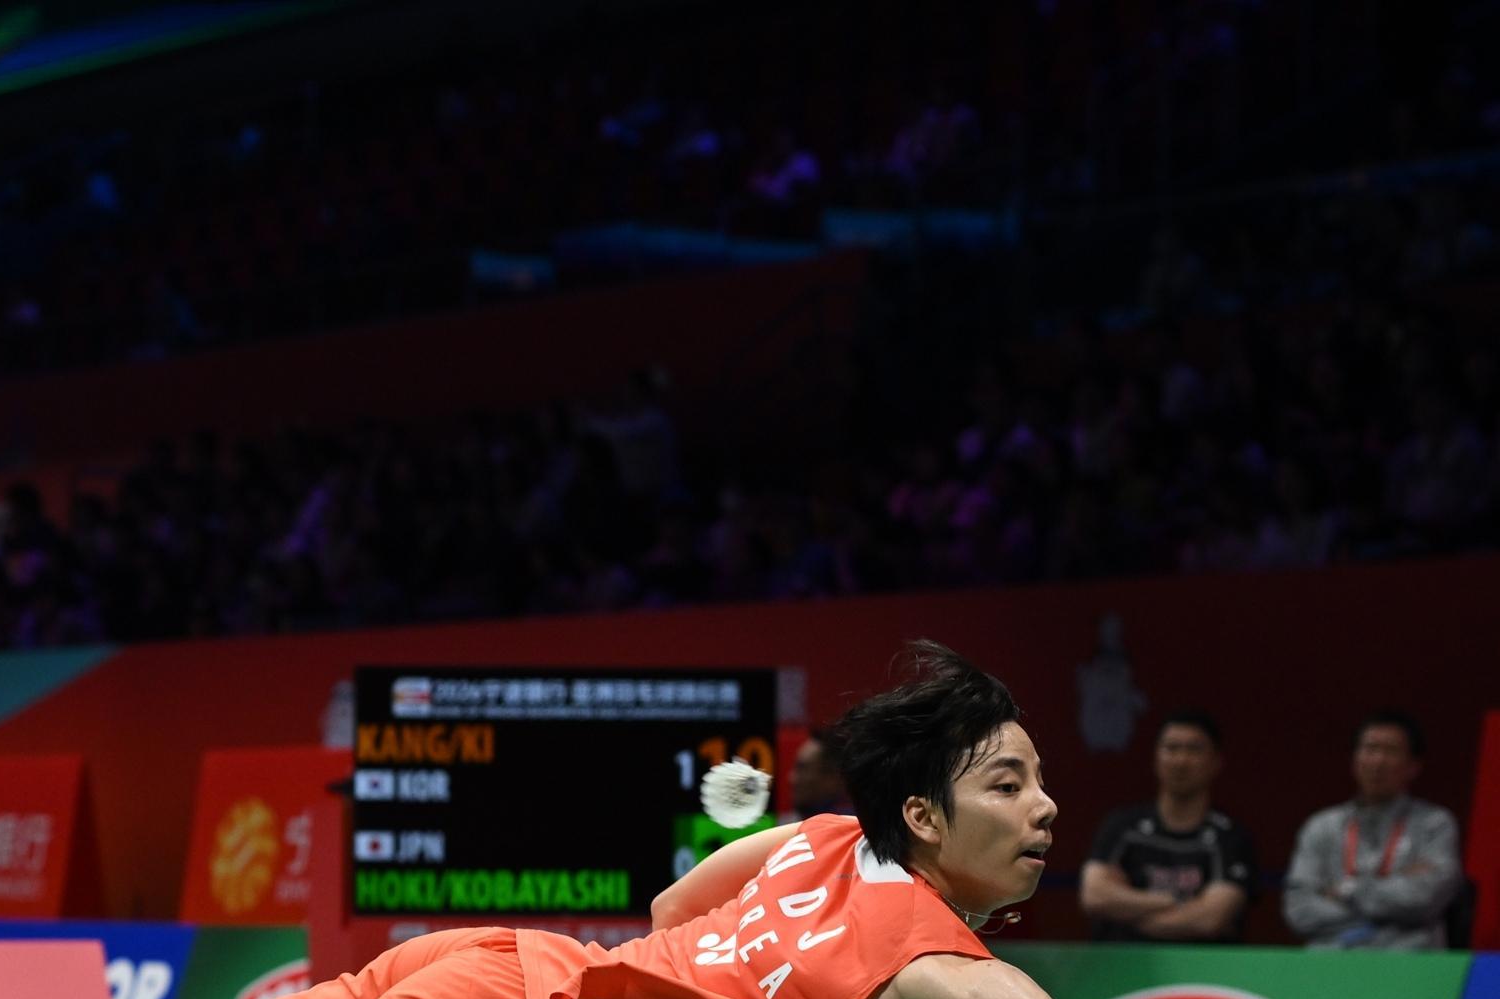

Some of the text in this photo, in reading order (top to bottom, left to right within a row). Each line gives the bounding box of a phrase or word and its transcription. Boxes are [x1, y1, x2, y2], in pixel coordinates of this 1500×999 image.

[357, 724, 495, 763] KANG/KI
[398, 770, 449, 800] KOR
[398, 831, 445, 862] JPN
[355, 869, 629, 910] HOKI/KOBAYASHI
